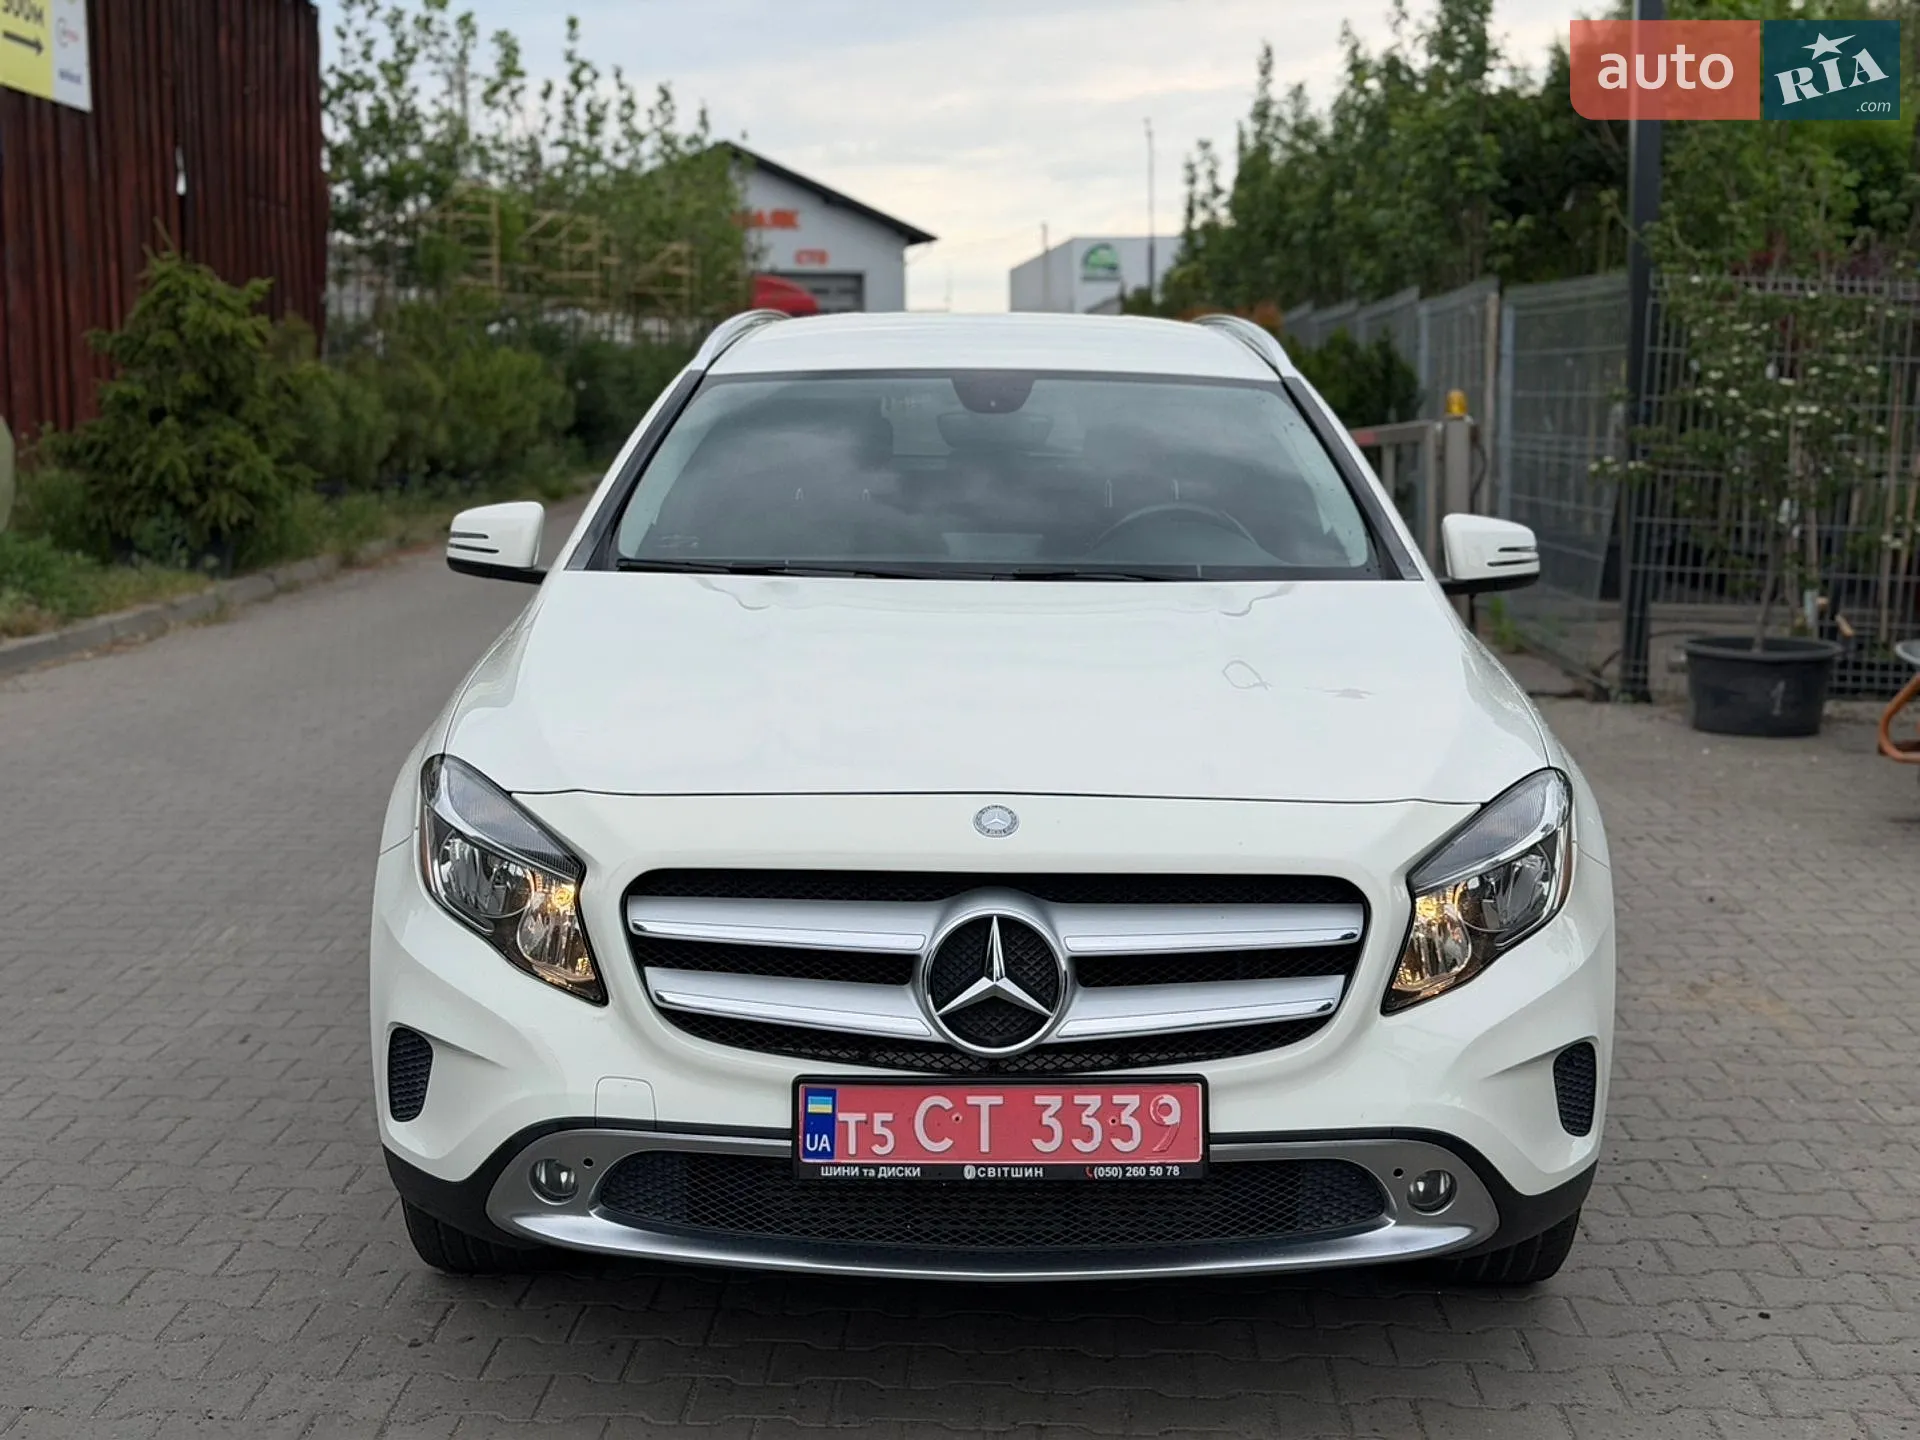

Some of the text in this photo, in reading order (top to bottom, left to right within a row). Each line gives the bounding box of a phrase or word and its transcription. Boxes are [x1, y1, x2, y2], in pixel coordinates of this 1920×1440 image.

[837, 1113, 895, 1155] T5
[1031, 1094, 1182, 1153] 3339
[806, 1134, 831, 1152] UA
[821, 1166, 921, 1179] ШИНИ та ДИСКИ
[1094, 1165, 1180, 1179] (050) 260 50 78
